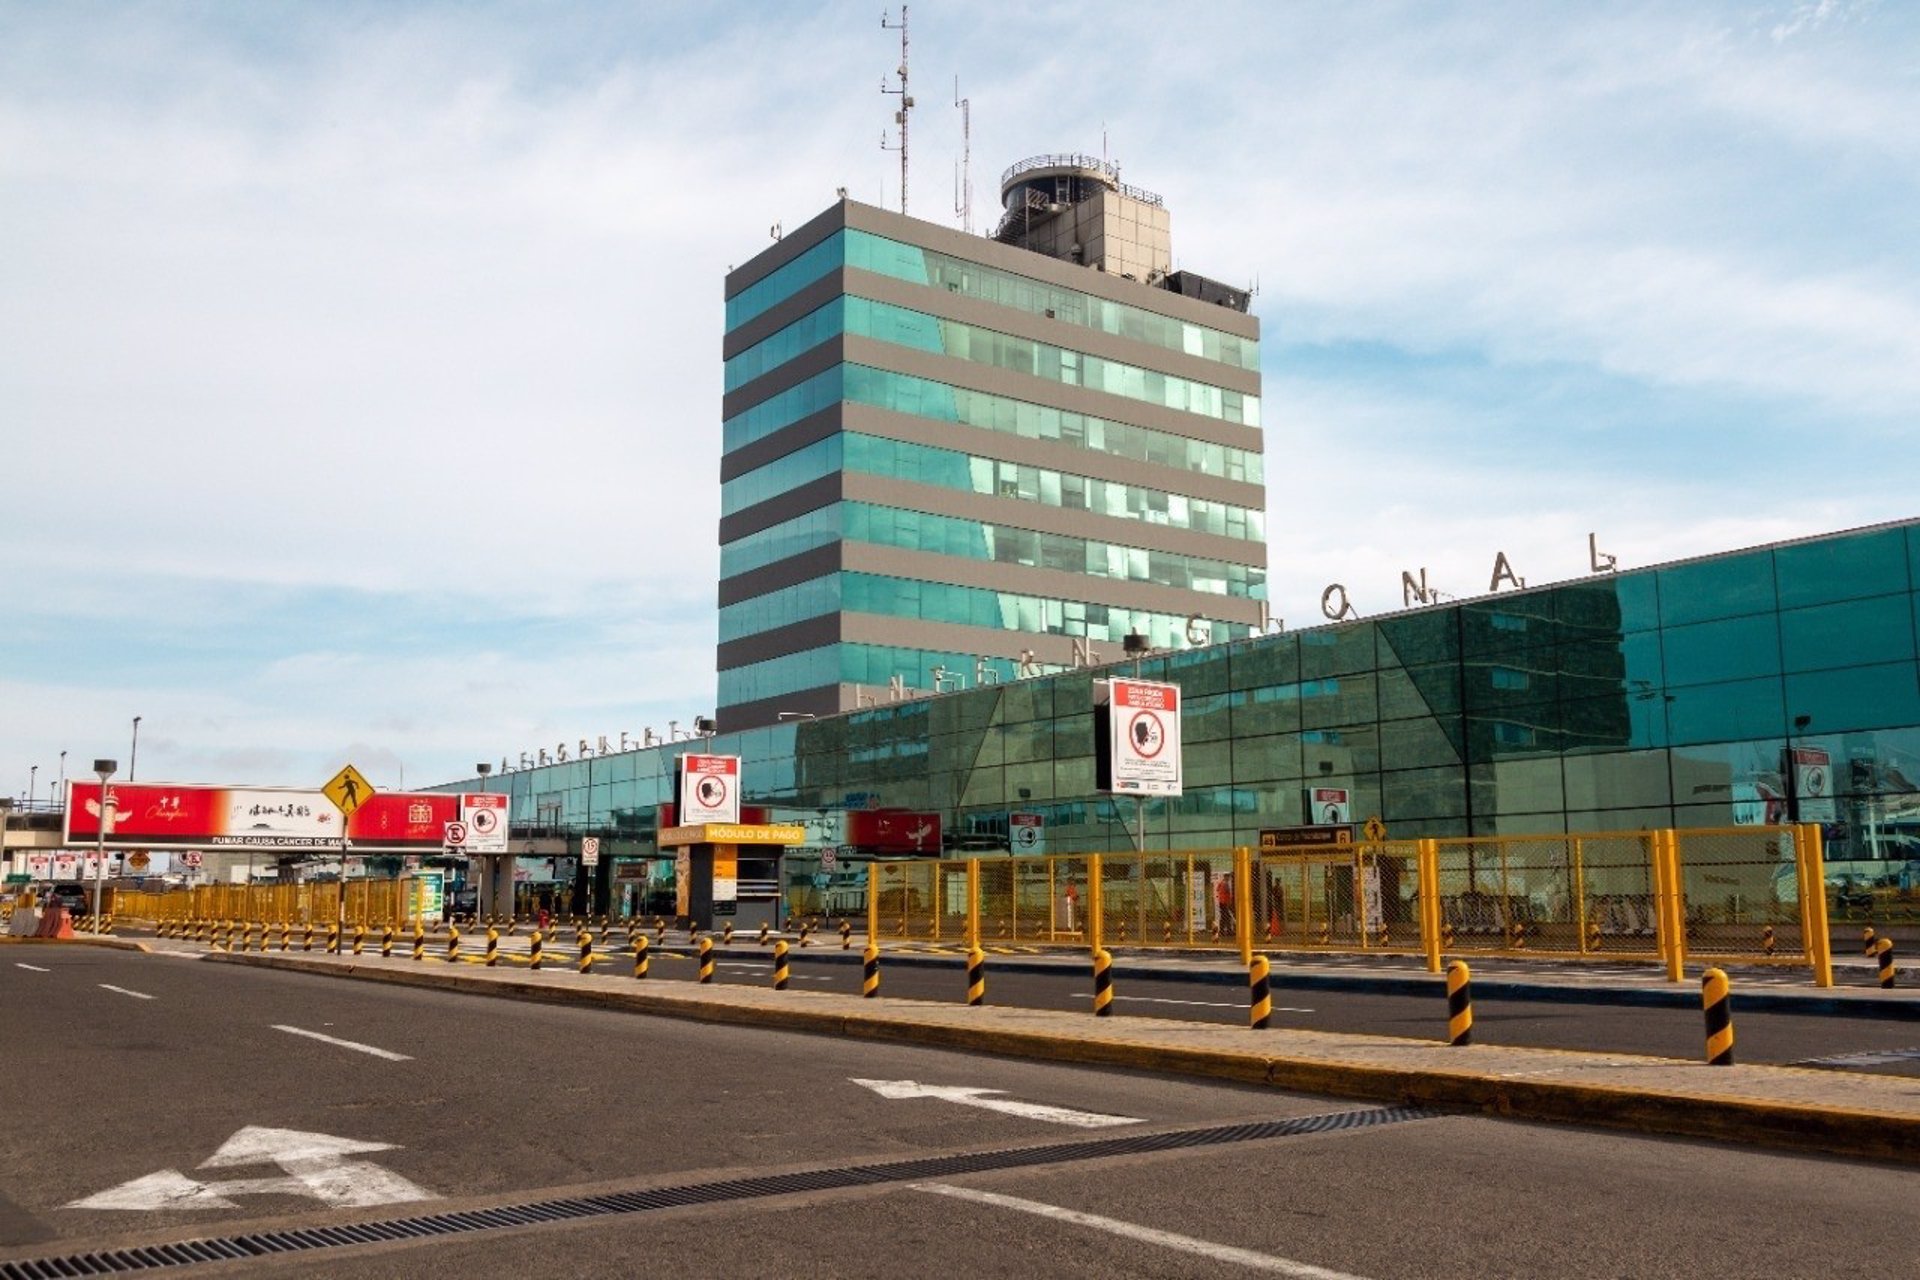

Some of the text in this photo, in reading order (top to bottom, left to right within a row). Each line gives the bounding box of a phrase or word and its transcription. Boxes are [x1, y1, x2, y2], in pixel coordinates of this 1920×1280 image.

[709, 827, 754, 840] MÓDULO
[757, 830, 769, 840] DE
[773, 830, 800, 840] PAGO
[212, 836, 244, 845] FUMAR
[245, 837, 275, 846] CAUSA
[315, 838, 326, 846] DE
